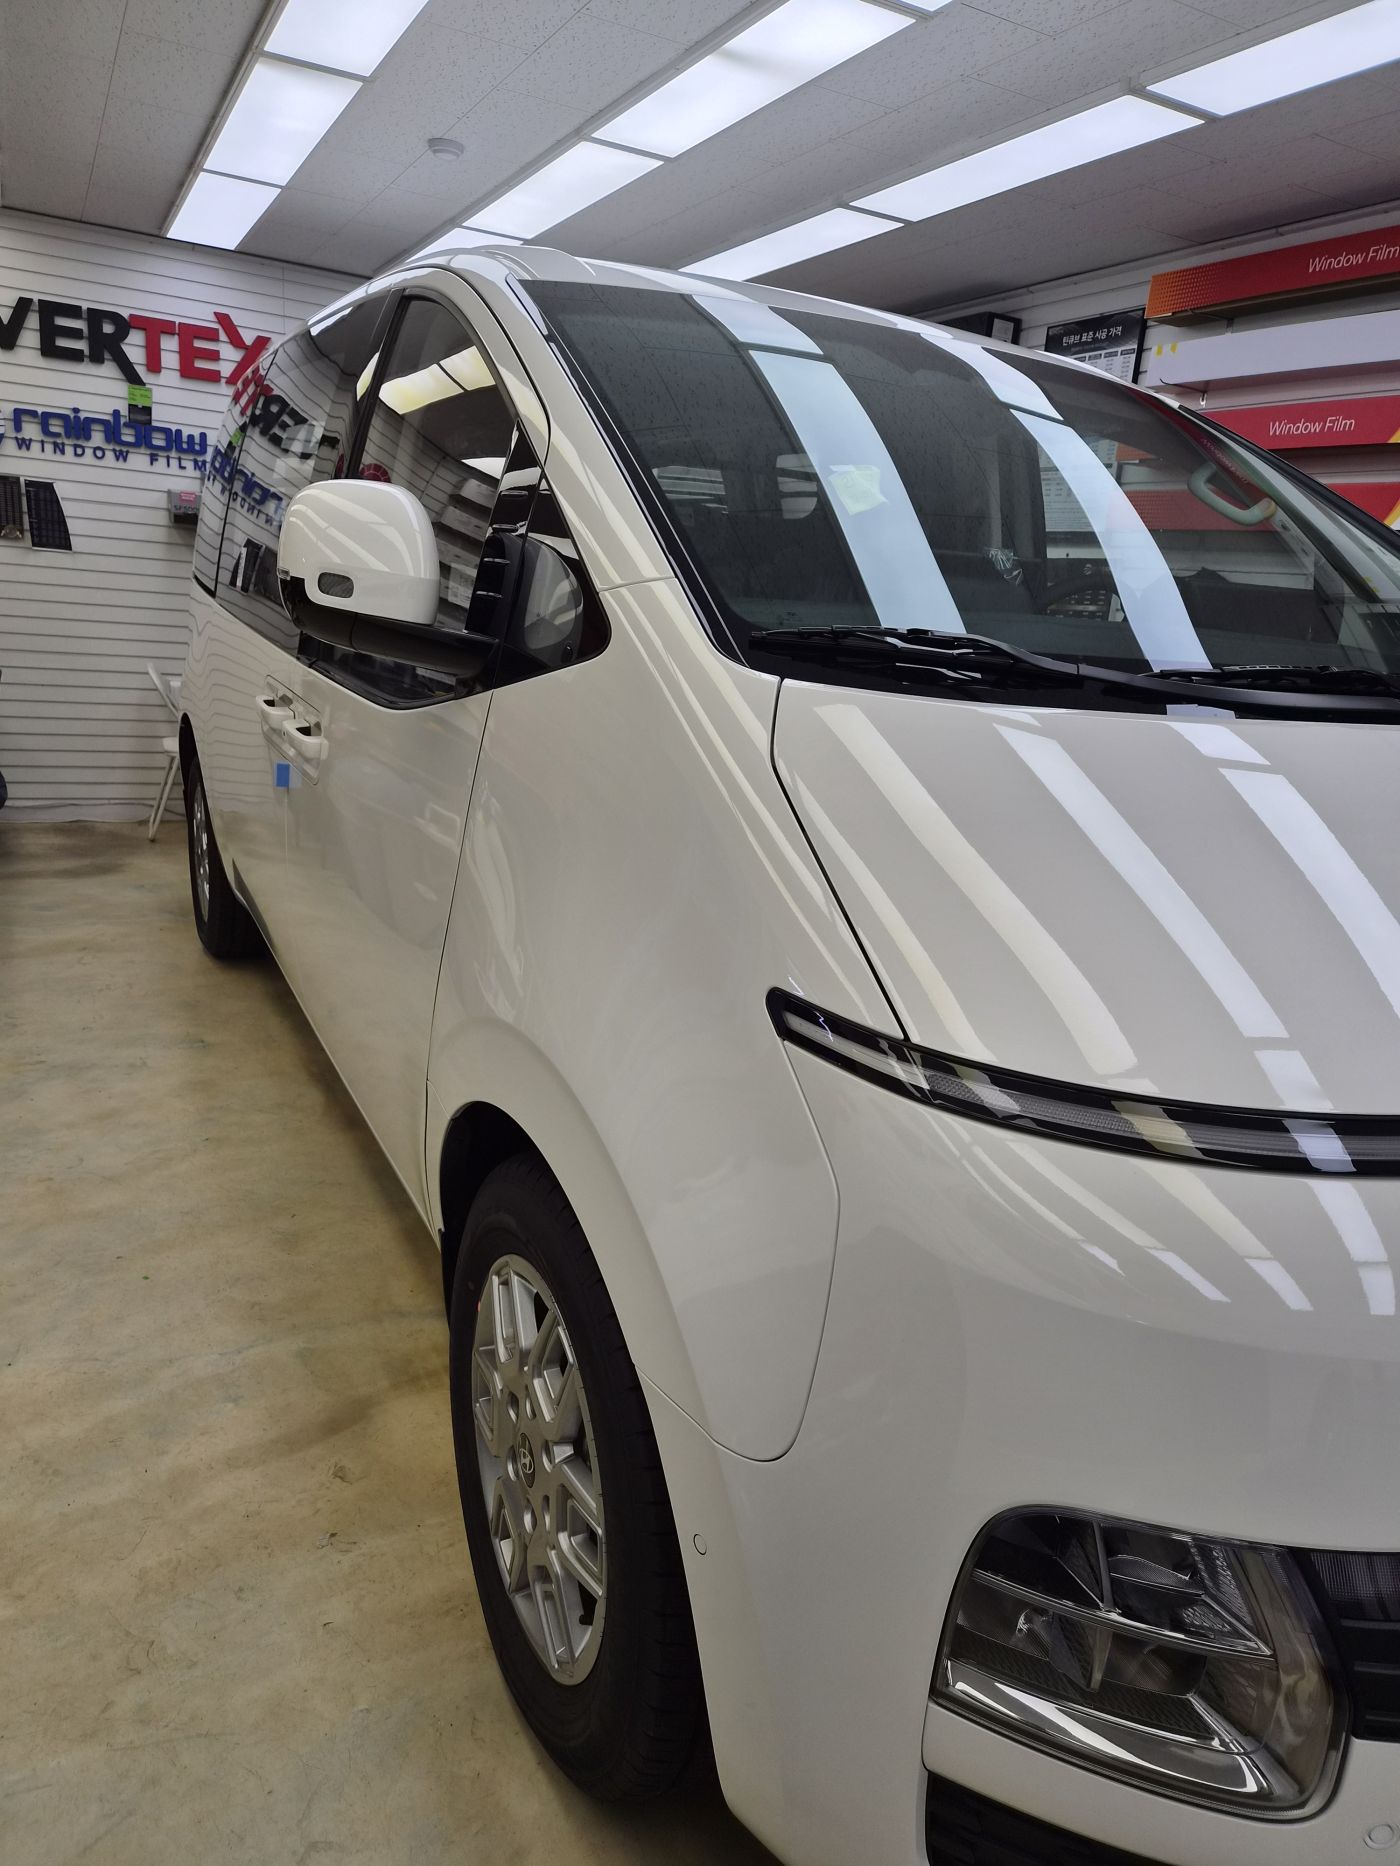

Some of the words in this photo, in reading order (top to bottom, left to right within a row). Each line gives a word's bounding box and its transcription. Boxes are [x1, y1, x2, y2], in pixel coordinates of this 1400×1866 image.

[1308, 251, 1366, 273] Window
[1366, 243, 1400, 263] Film
[1094, 328, 1108, 340] 시공
[1108, 325, 1123, 337] 가격
[13, 407, 208, 455] rainbow
[1269, 418, 1323, 436] Window
[1324, 415, 1355, 433] Film
[15, 436, 130, 463] WINDOW
[149, 452, 208, 472] FILM
